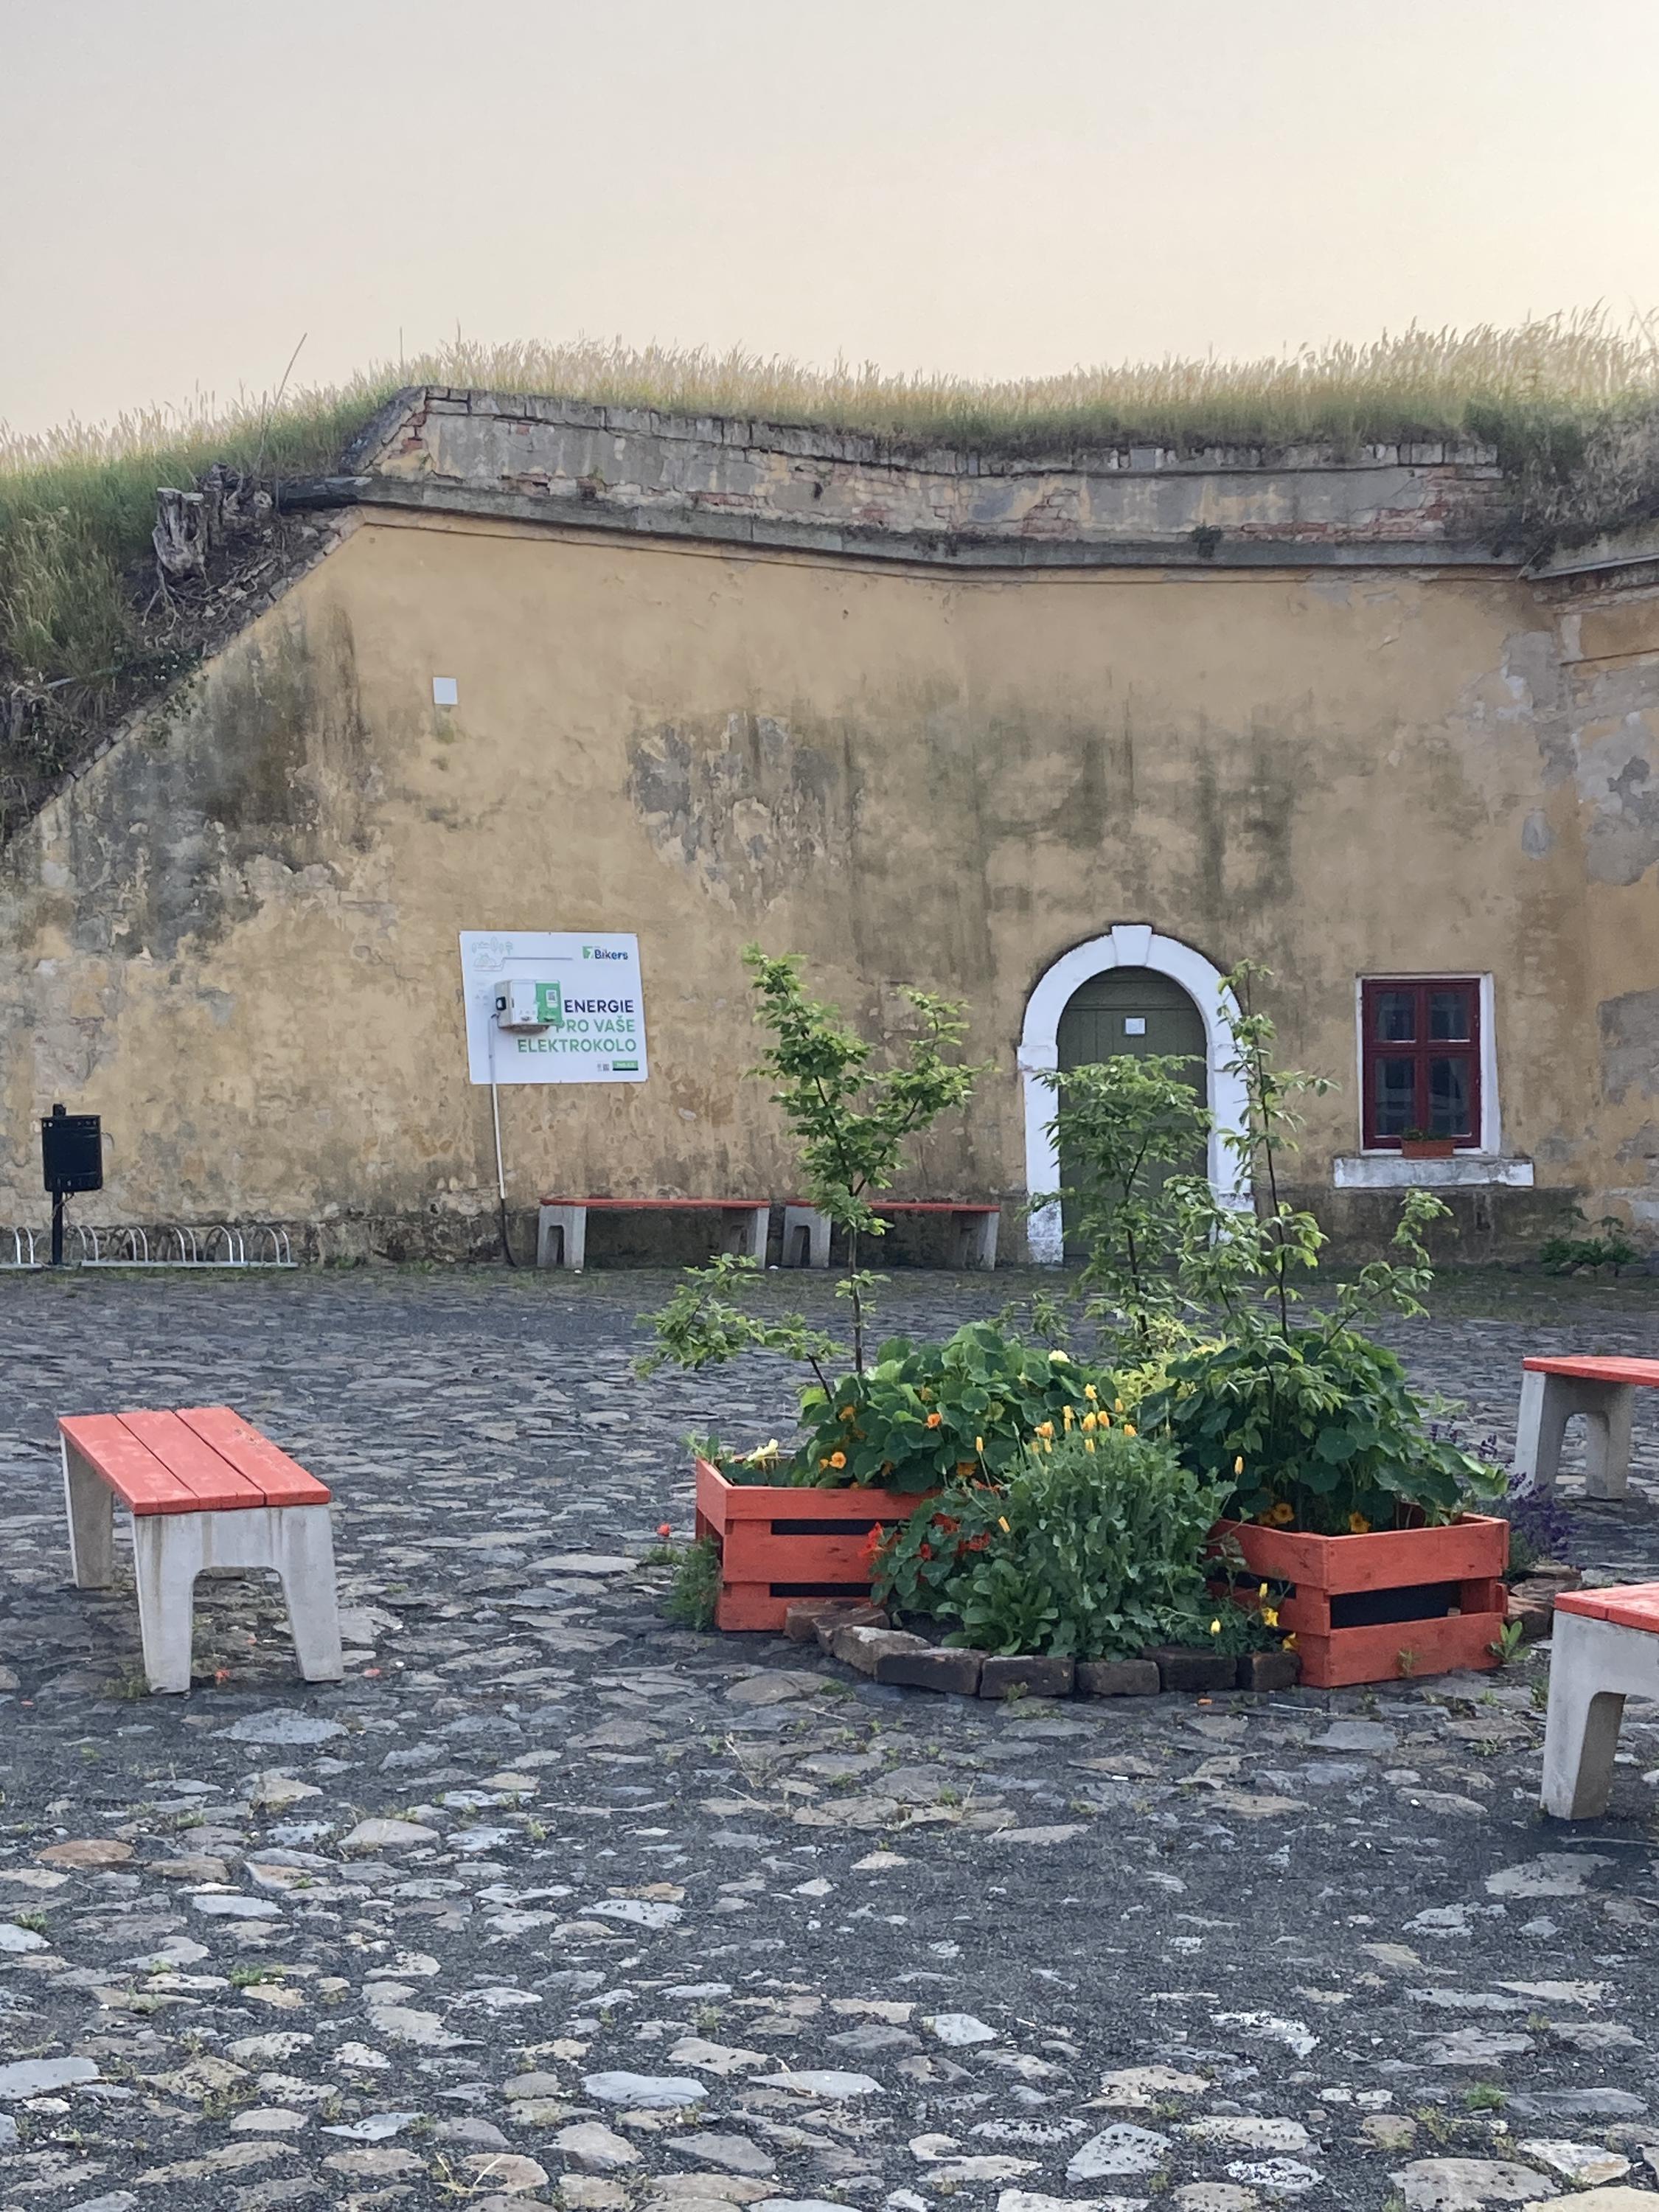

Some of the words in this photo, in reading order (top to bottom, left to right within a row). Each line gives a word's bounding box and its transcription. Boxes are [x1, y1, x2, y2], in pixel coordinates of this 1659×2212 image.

[594, 948, 628, 959] Bikers
[564, 999, 634, 1013] ENERGIE
[594, 1015, 636, 1032] VAŠE
[518, 1038, 637, 1053] ELEKTROKOLO
